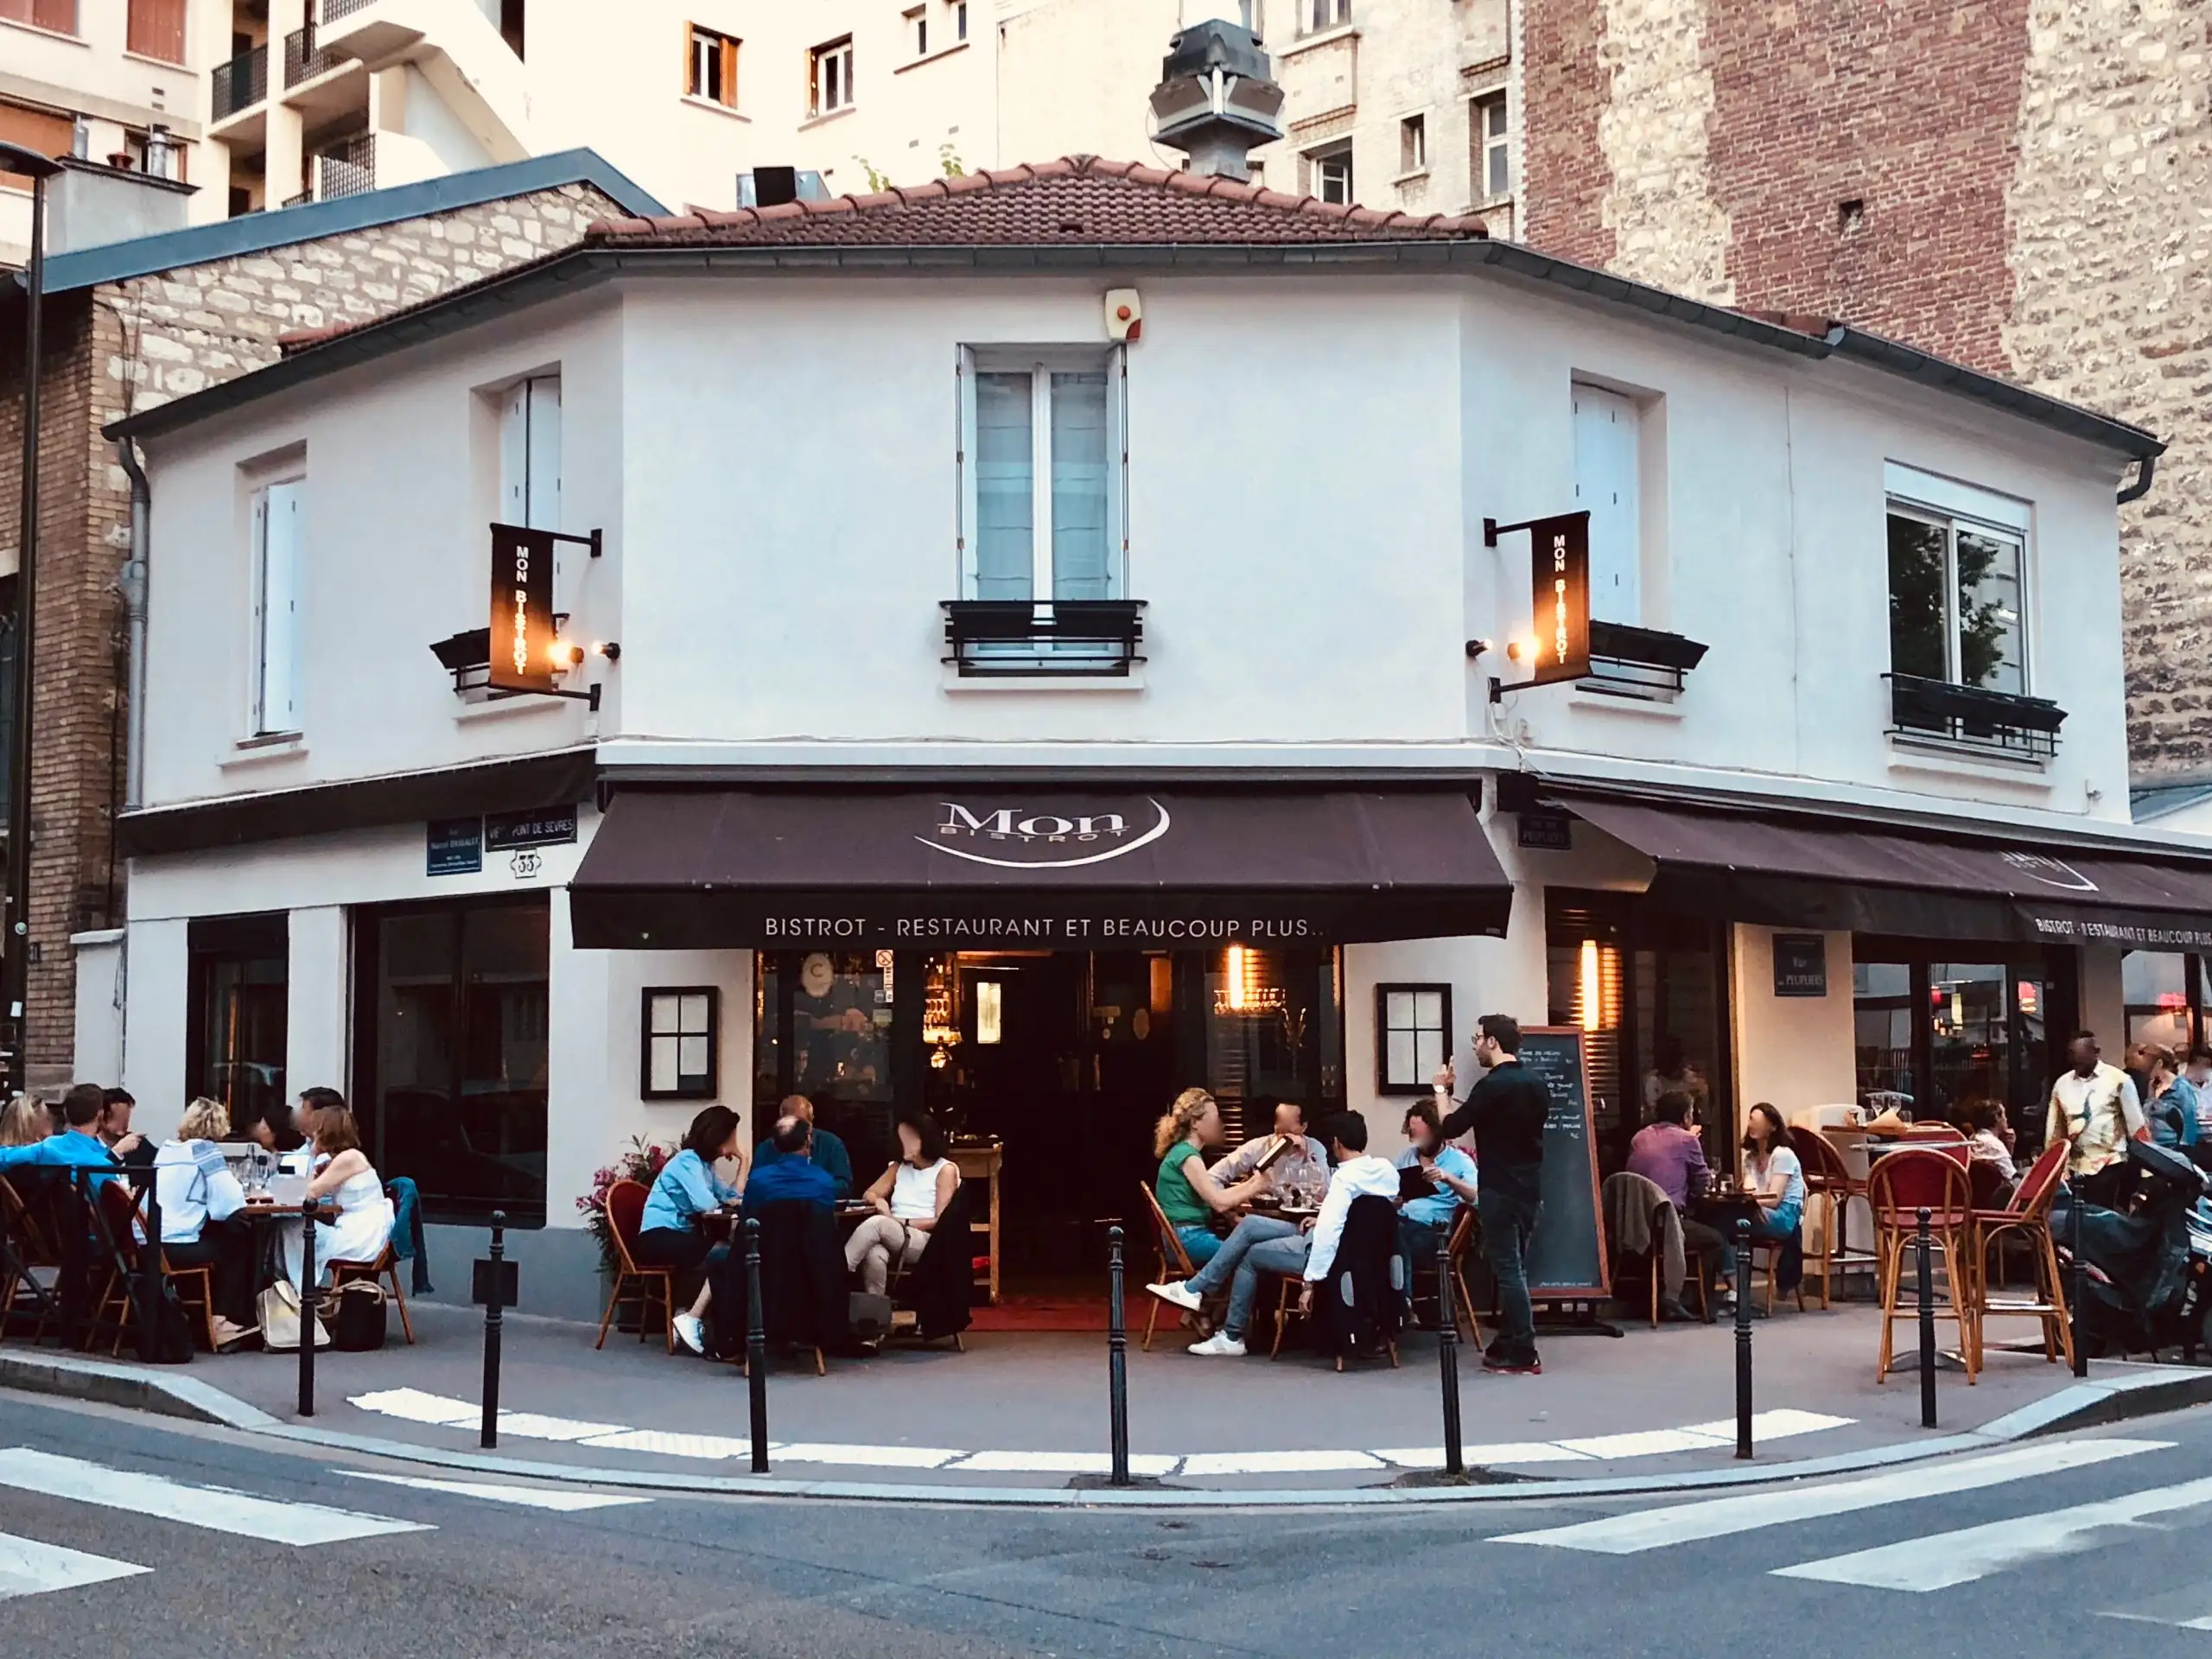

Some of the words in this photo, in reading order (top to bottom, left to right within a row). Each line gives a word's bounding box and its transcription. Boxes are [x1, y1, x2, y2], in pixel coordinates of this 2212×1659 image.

[516, 545, 529, 582] MON
[1554, 534, 1566, 572] MON
[938, 802, 1131, 836] Mon
[940, 826, 1127, 842] BISTROT
[766, 918, 866, 937] BISTROT
[897, 918, 1053, 936] RESTAURANT
[1065, 919, 1091, 937] ET
[1103, 919, 1239, 938] BEAUCOUP
[2035, 918, 2074, 934] BISTROT
[2147, 927, 2193, 944] BEAUCOUP
